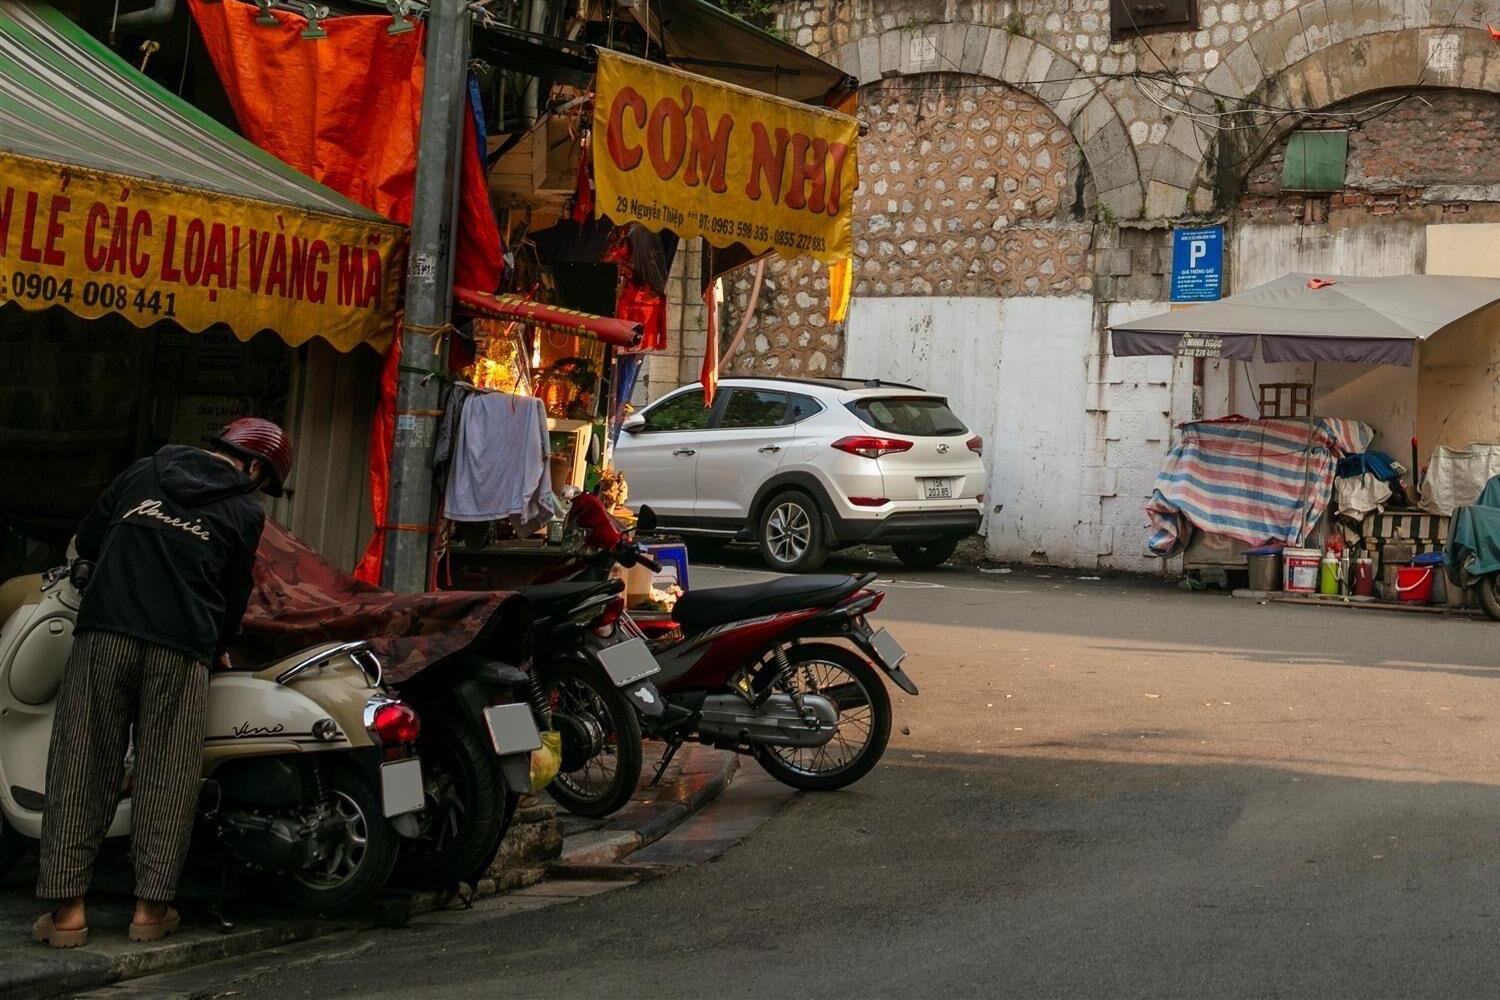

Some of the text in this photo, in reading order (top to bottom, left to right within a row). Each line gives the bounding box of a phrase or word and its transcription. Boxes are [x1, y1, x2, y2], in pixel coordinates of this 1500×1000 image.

[606, 84, 734, 194] CƠM
[616, 196, 628, 212] 29
[711, 219, 734, 236] 0963
[753, 225, 768, 242] 335
[83, 188, 153, 279] CÁC
[160, 215, 240, 302] LOẠI
[248, 215, 330, 304] VÀNG
[337, 233, 382, 309] MÃ
[1190, 240, 1206, 268] P
[12, 271, 176, 316] 0904 008 441
